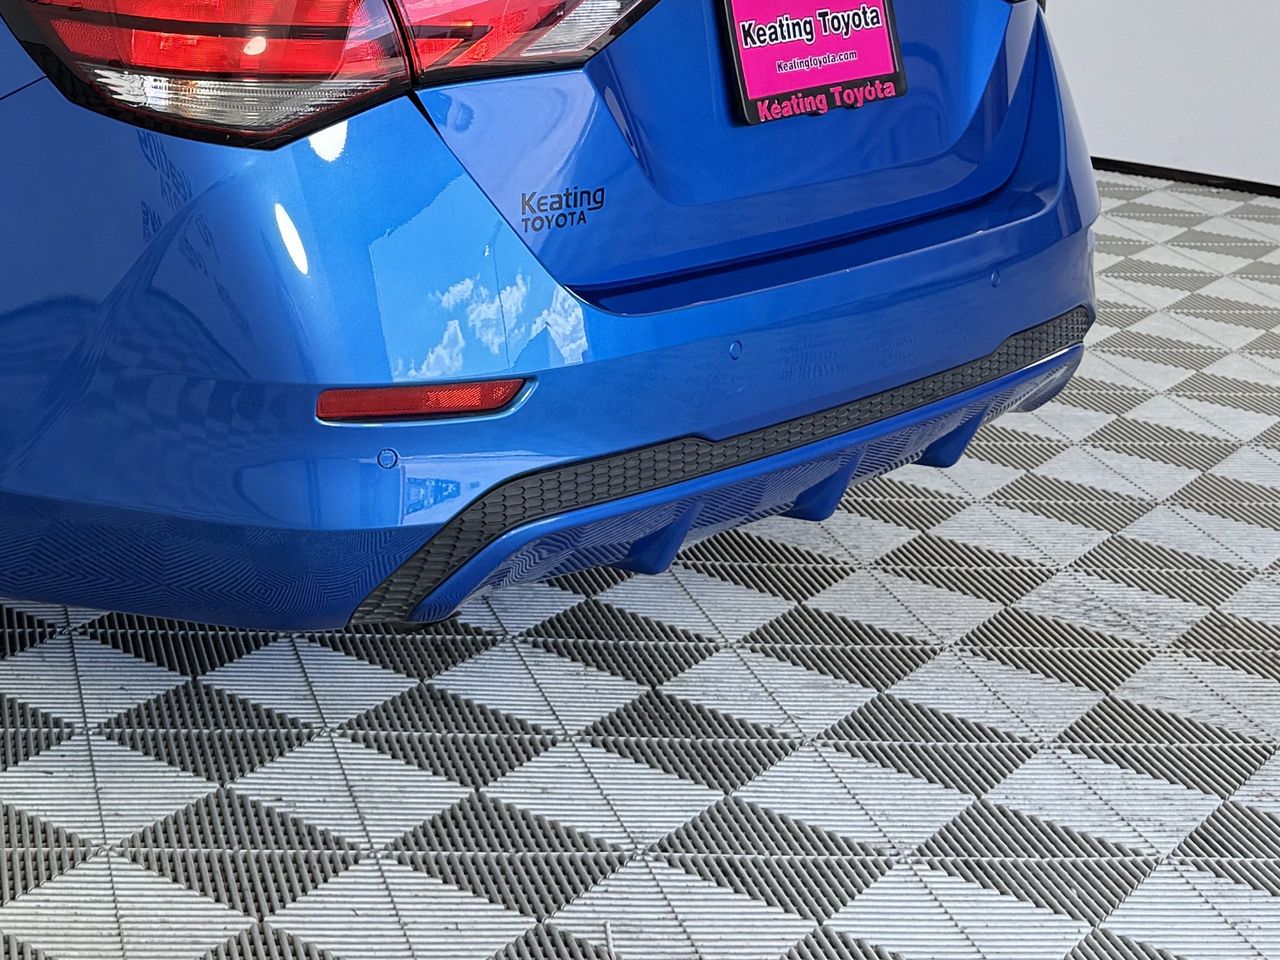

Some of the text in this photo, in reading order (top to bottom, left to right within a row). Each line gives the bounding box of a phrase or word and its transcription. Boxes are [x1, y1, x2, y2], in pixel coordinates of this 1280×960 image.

[741, 5, 882, 47] Keating Toyota
[776, 50, 858, 73] Keatingtoyota.com
[757, 80, 896, 122] Keating Toyota
[521, 186, 605, 215] Keating
[521, 210, 587, 233] TOYOTA
